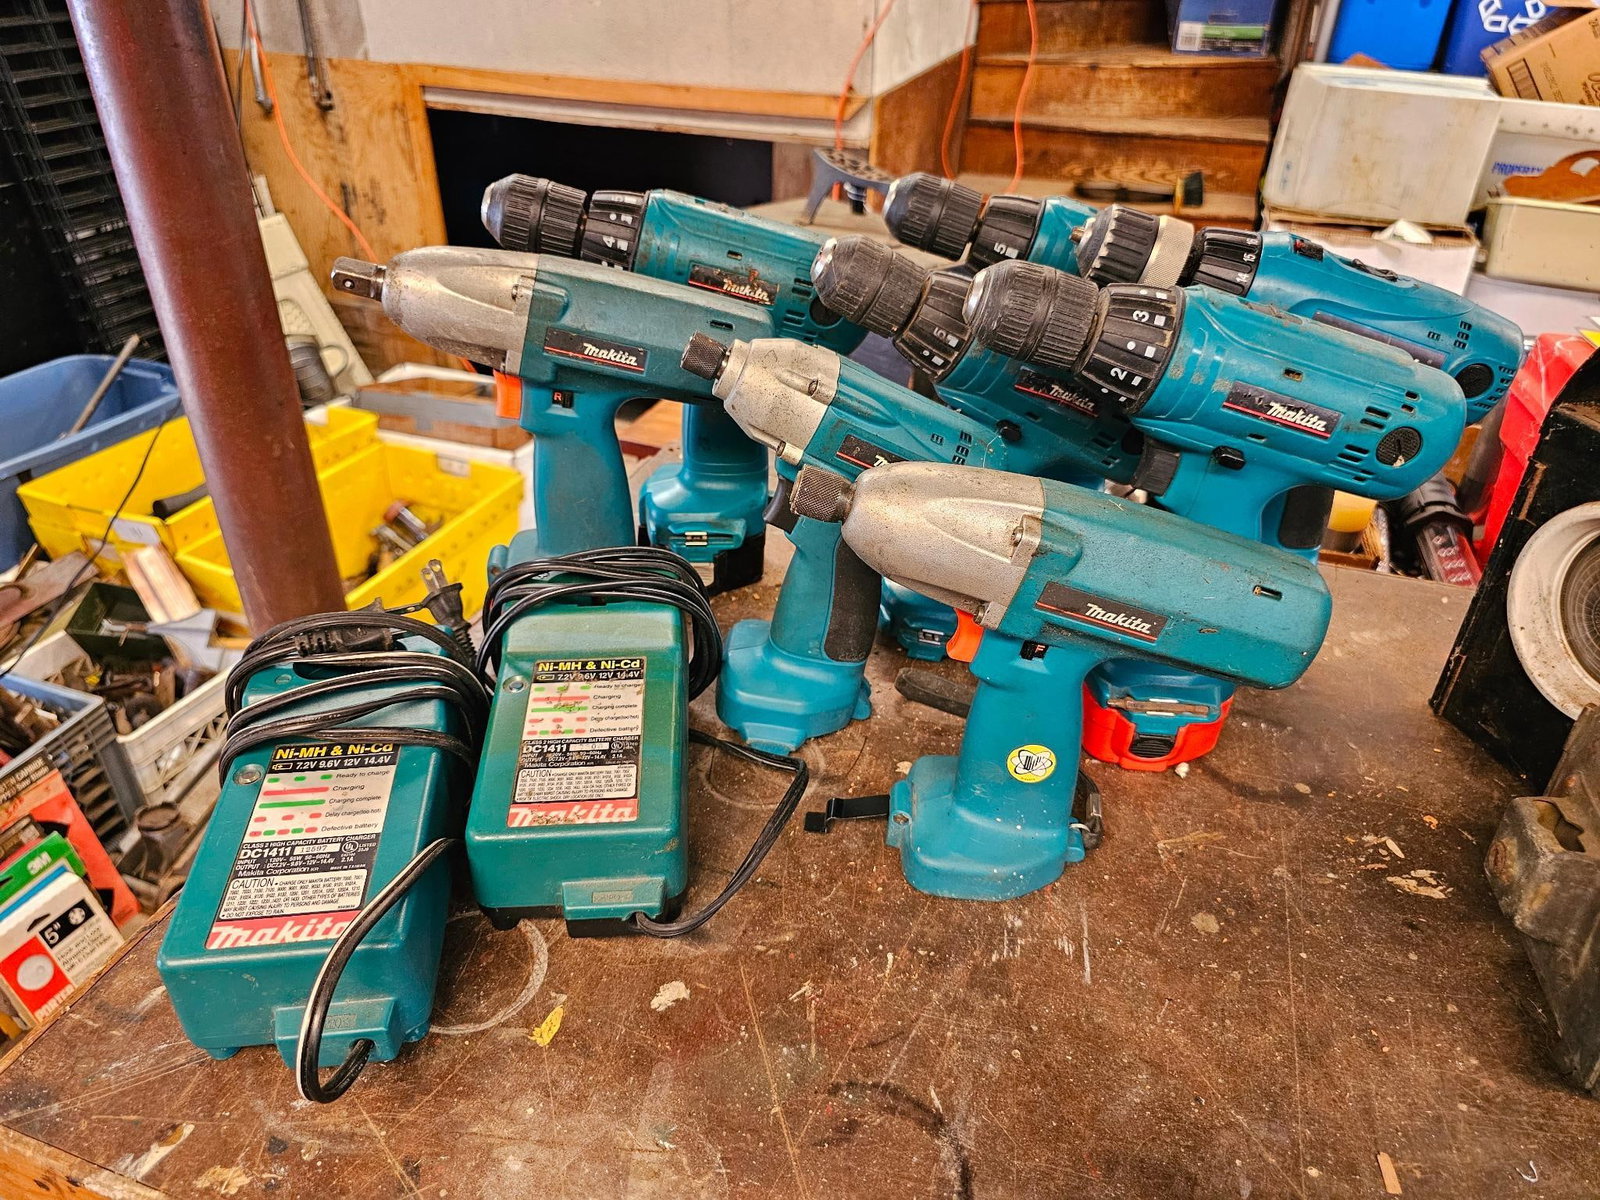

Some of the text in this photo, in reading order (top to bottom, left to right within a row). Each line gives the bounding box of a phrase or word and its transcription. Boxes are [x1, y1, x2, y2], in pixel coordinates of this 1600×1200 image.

[603, 235, 615, 248] 4
[994, 242, 1007, 255] 5
[1243, 252, 1256, 262] 15
[1236, 273, 1249, 282] 14
[1132, 310, 1150, 323] 3
[933, 326, 947, 340] 5
[1110, 367, 1128, 381] 2
[554, 392, 562, 401] R
[1035, 645, 1046, 654] F
[538, 660, 640, 672] Ni-MH & Ni-Cd
[275, 743, 394, 760] Ni-MH & Ni-Cd
[523, 744, 566, 754] DC1411
[295, 756, 391, 770] 7.2V 9.6V 12V 14.4V
[521, 770, 552, 778] CAUTION
[332, 784, 365, 792] Charging
[328, 797, 354, 806] Charging
[320, 822, 378, 832] Defective battery
[286, 838, 316, 847] CAPACITY
[316, 836, 344, 844] BATTERY
[345, 834, 376, 842] CHARGER
[240, 848, 292, 860] DC1411
[26, 850, 52, 876] 3M
[266, 867, 310, 876] Corporation
[232, 878, 275, 890] CAUTION
